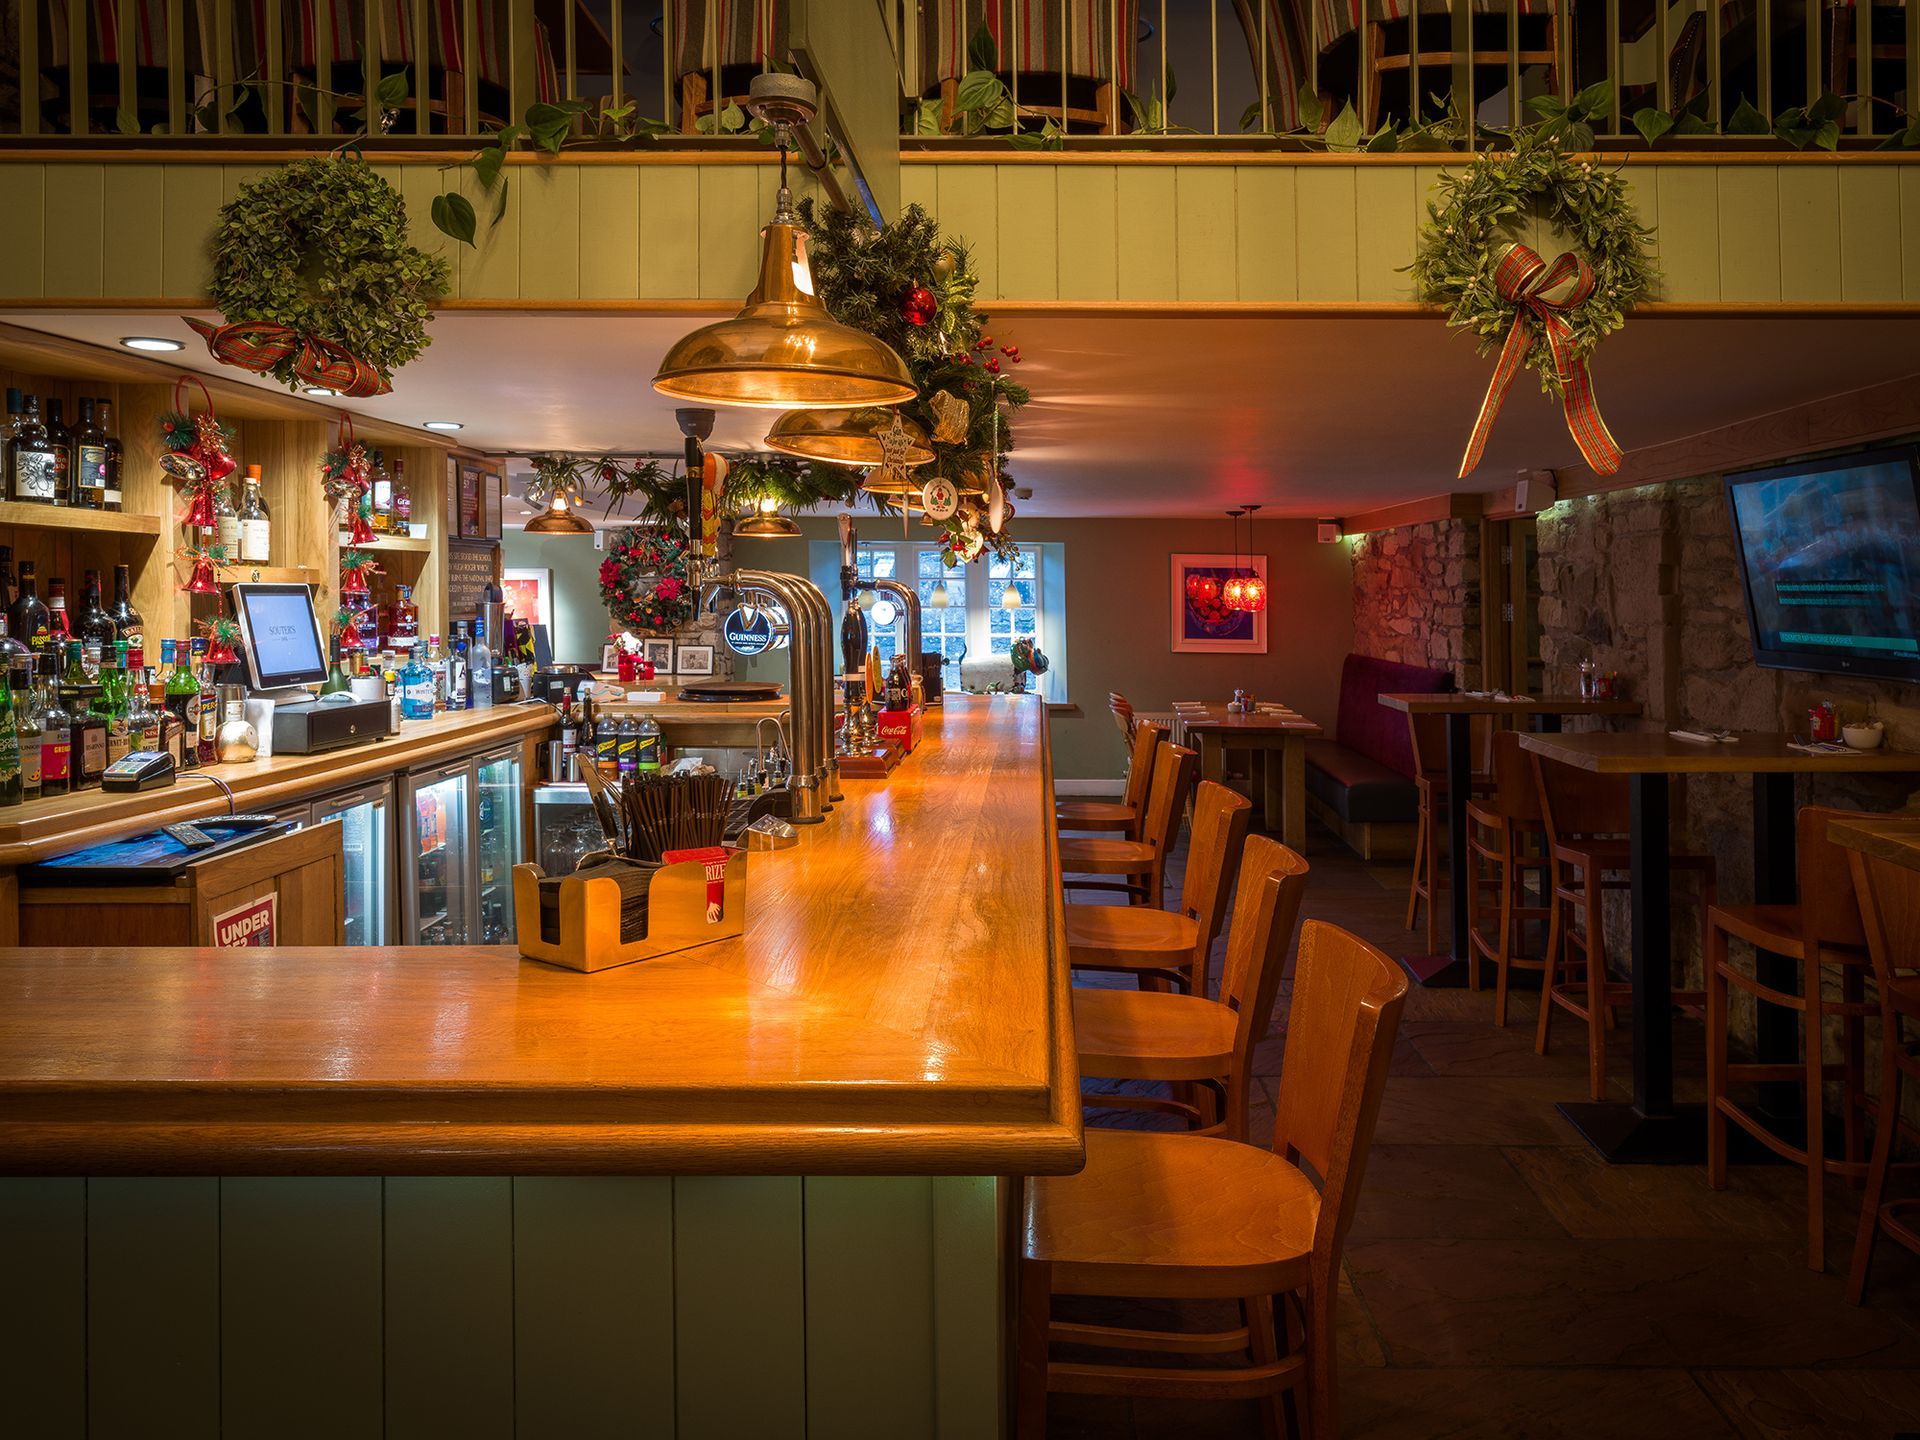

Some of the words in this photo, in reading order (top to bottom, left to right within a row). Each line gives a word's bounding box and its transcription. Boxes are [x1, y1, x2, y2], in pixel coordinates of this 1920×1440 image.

[268, 625, 296, 635] SOUTERS
[729, 632, 767, 642] GUINNESS
[881, 725, 907, 735] Coca-Cola
[221, 910, 270, 945] UNDER
